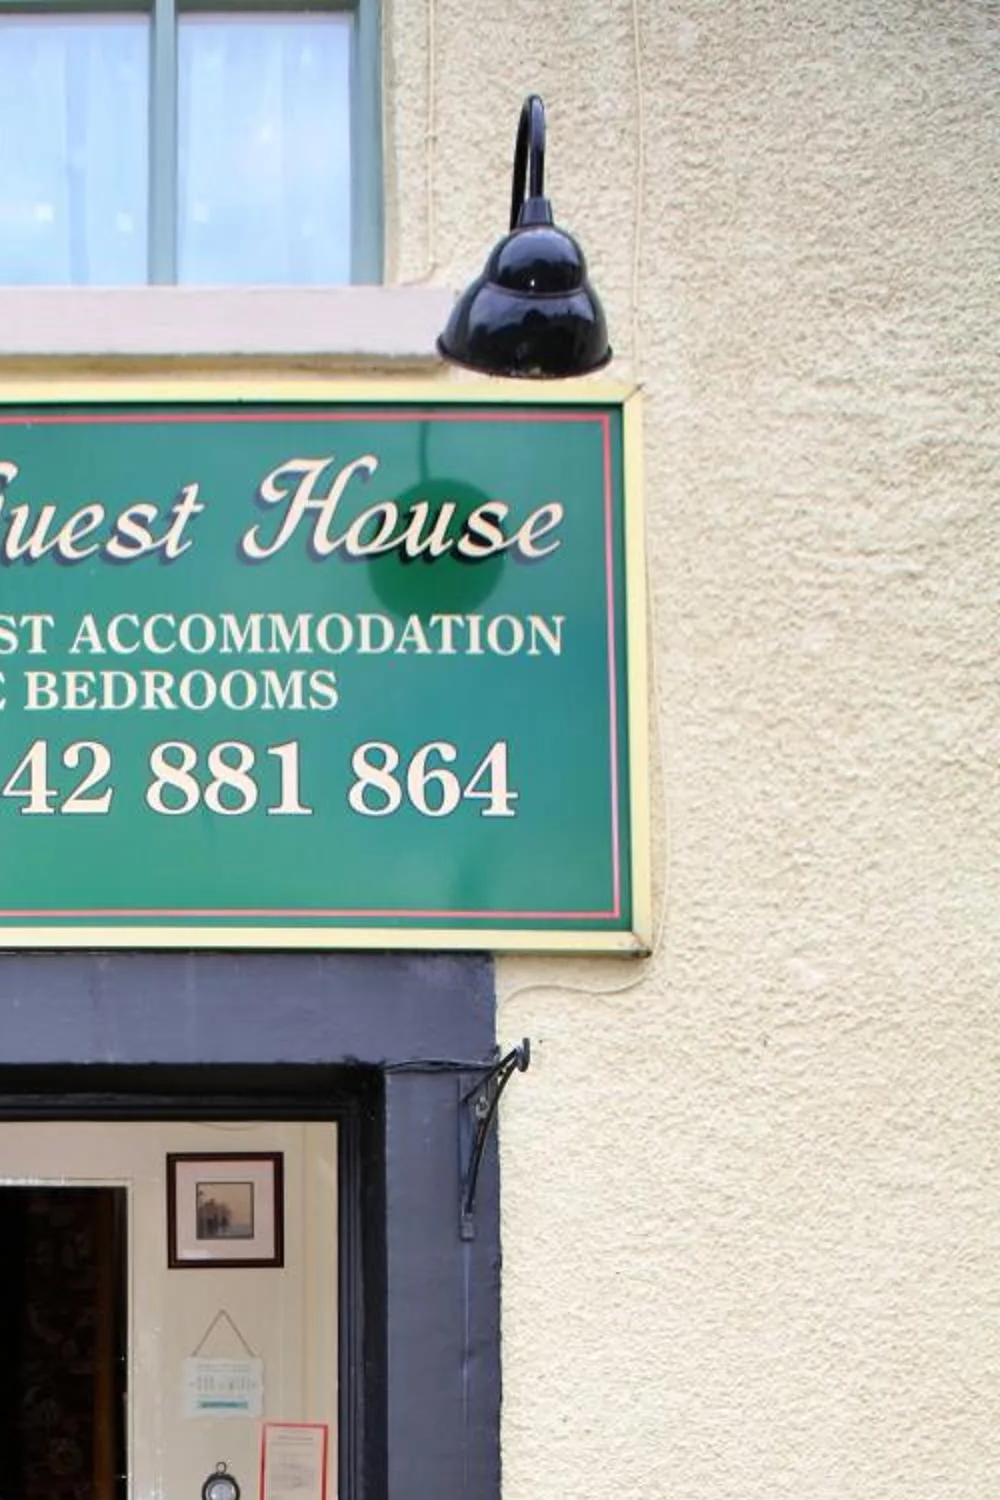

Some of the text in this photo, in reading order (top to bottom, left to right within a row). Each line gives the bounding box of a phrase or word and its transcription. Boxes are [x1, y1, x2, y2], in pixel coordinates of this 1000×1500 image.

[242, 455, 565, 561] House
[69, 612, 566, 654] ACCOMMODATION
[23, 669, 339, 711] BEDROOMS
[146, 740, 313, 815] 881
[348, 741, 519, 817] 864
